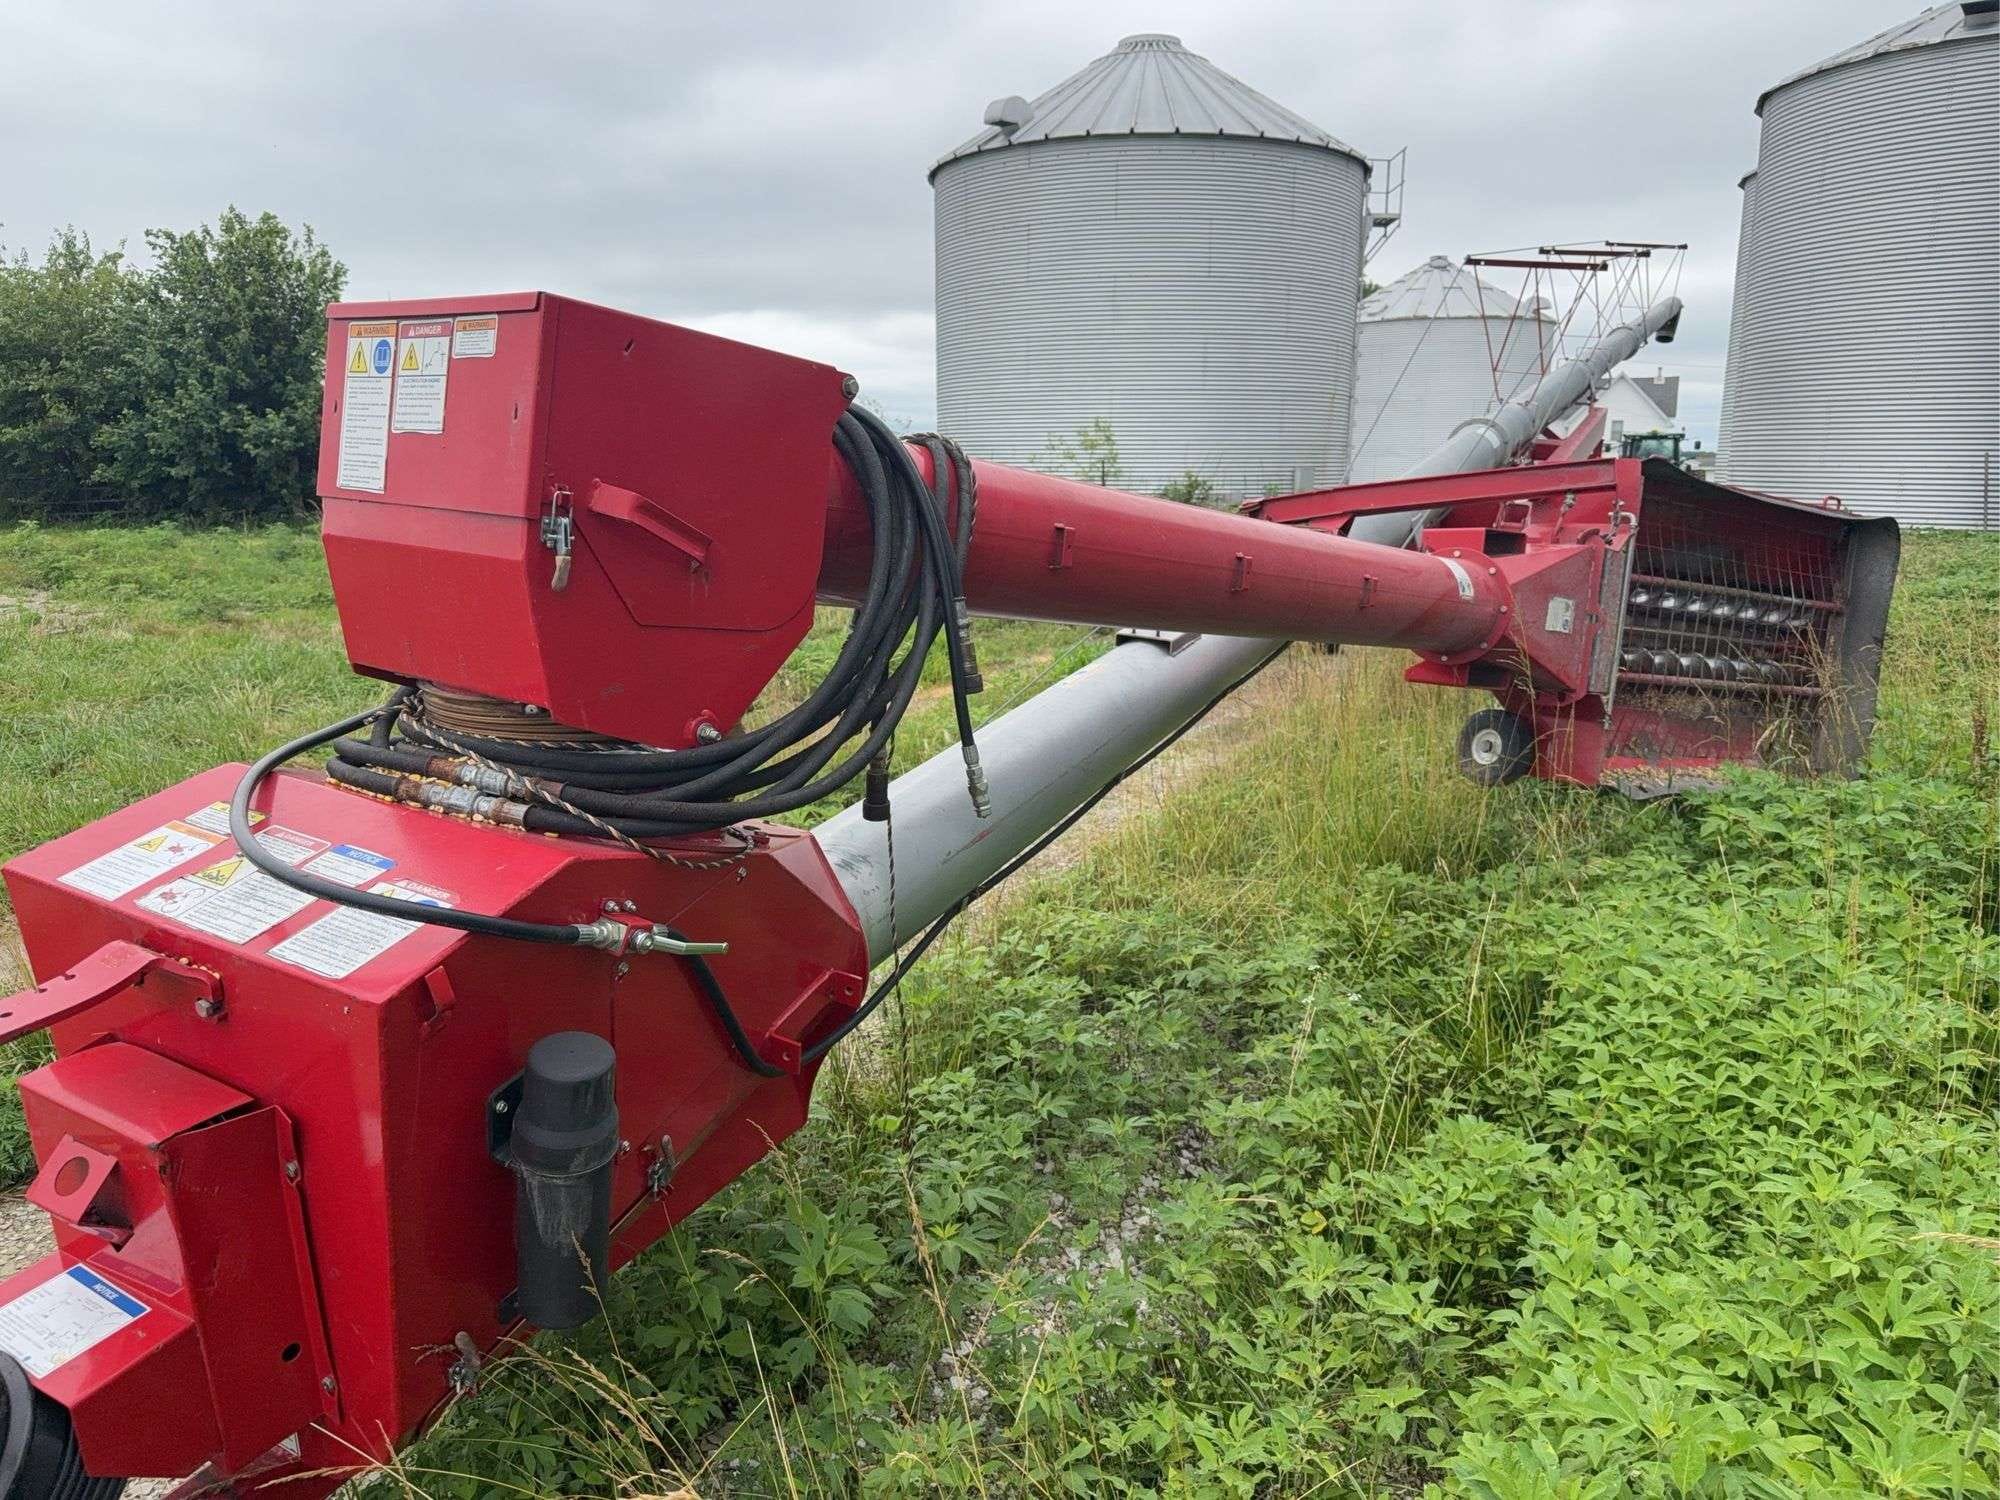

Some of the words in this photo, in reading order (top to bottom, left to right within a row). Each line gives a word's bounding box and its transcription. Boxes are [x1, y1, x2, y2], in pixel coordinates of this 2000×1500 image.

[415, 325, 442, 335] DANGER
[283, 831, 315, 846] DANGER
[347, 850, 383, 864] NOTICE
[407, 883, 450, 899] DANGER
[94, 1283, 120, 1301] NOTICE
